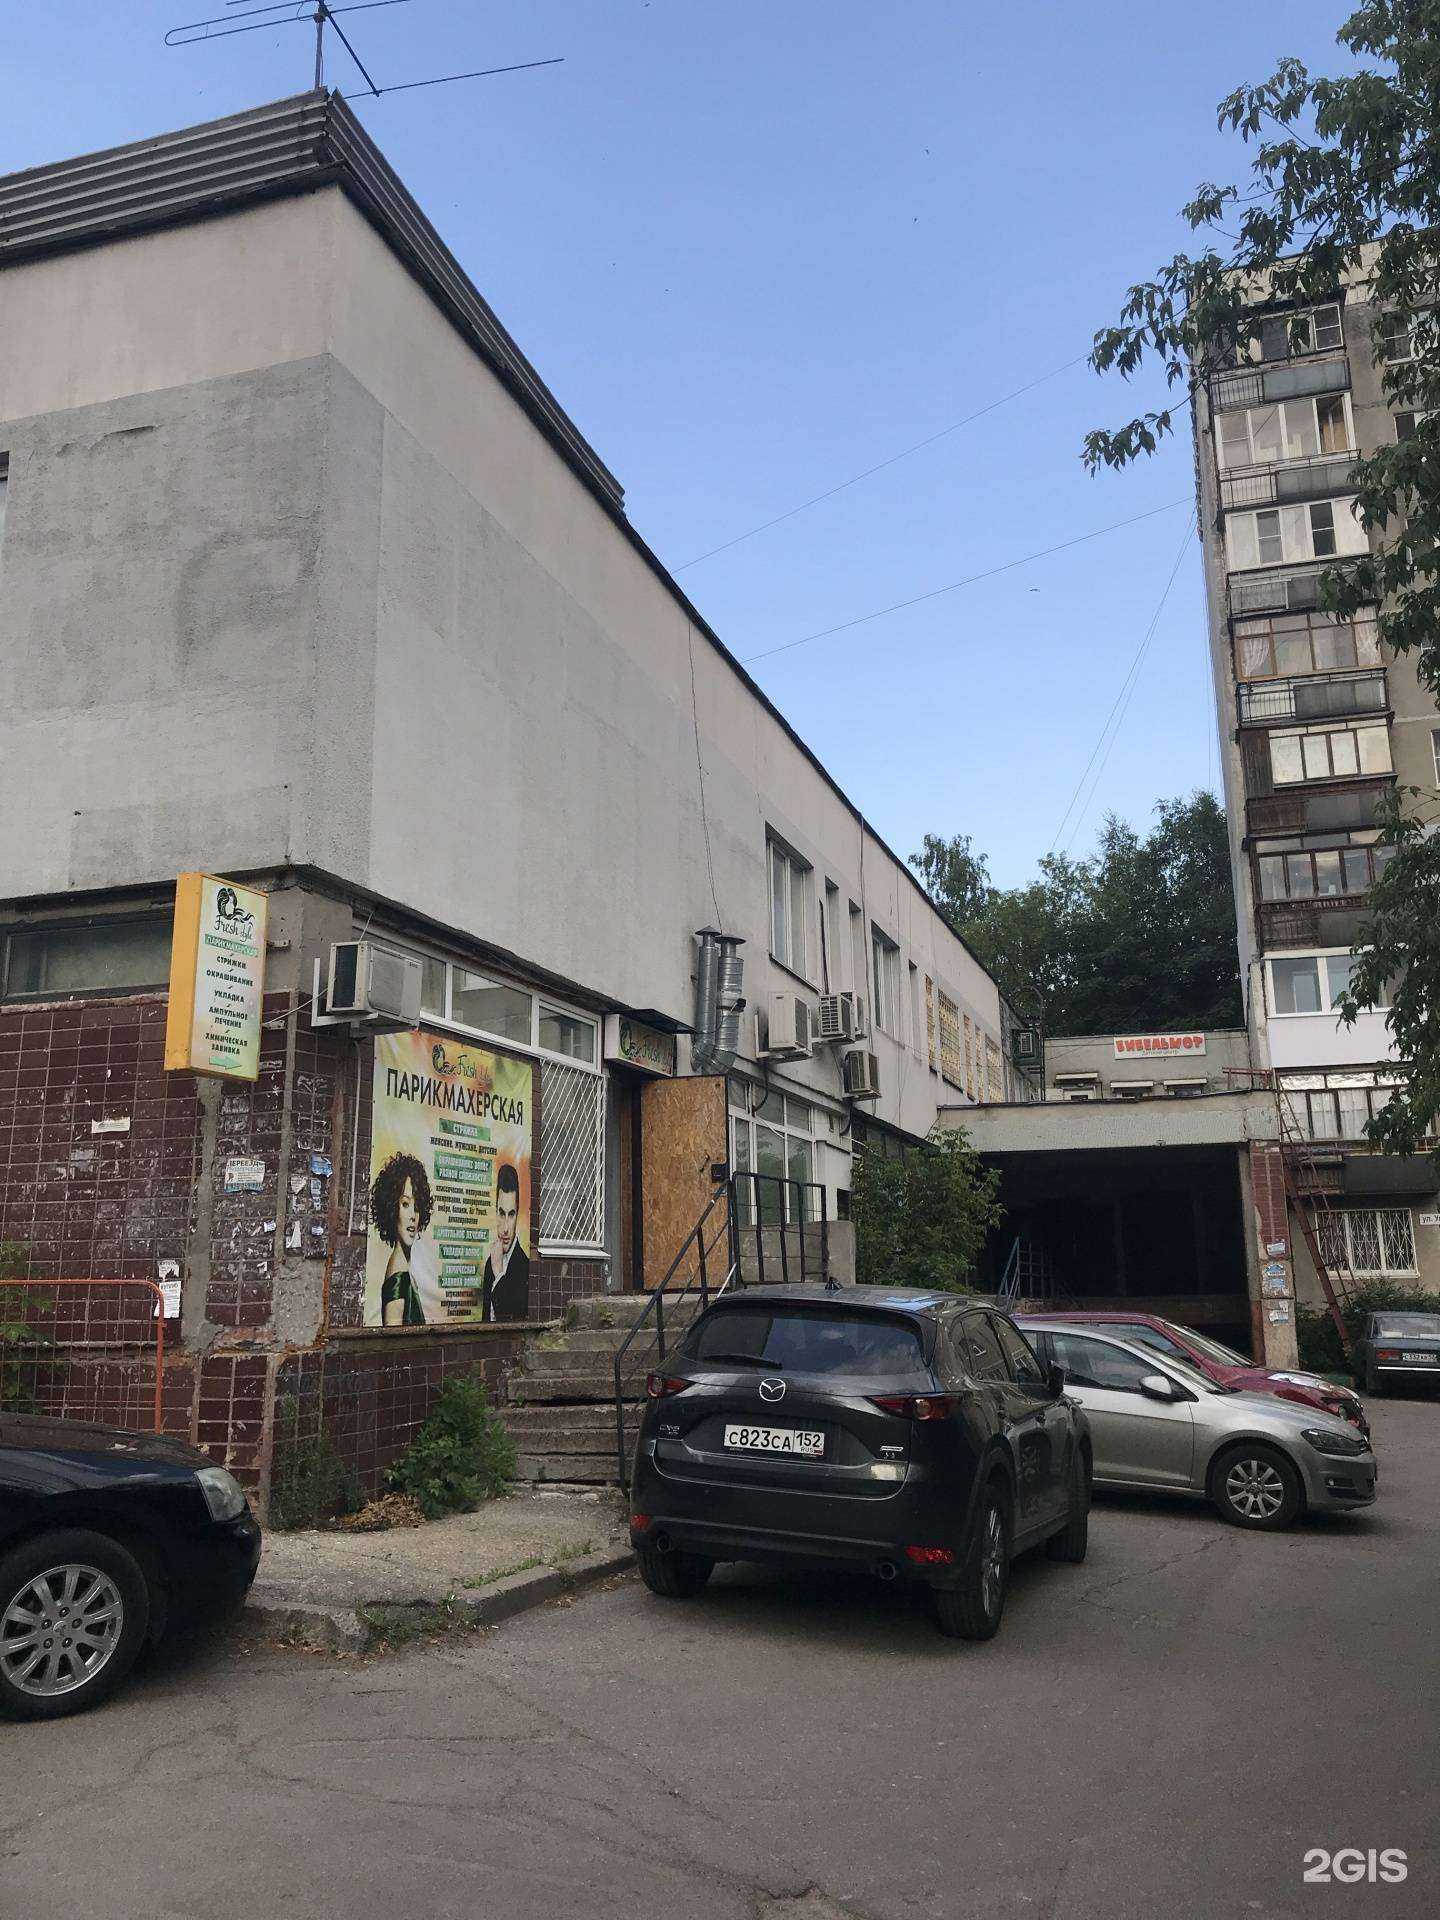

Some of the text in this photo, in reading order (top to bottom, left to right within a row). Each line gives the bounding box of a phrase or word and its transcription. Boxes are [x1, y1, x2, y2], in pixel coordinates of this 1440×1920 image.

[214, 914, 239, 936] Fresh
[216, 955, 247, 970] СТРИЖКИ
[206, 969, 254, 987] ОКРАШИВАНИЕ
[214, 990, 245, 1003] УКЛАДКА
[209, 1006, 248, 1021] АМПУЛЬНОЕ
[214, 1017, 242, 1029] ЛЕЧЕНИЕ
[205, 1032, 248, 1047] ХИМИЧЕСКАЯ
[211, 1043, 240, 1055] ЗАВИВКА
[386, 1067, 524, 1126] ПАРИКМАХЕРСКАЯ
[728, 1428, 821, 1450] С823СА 152
